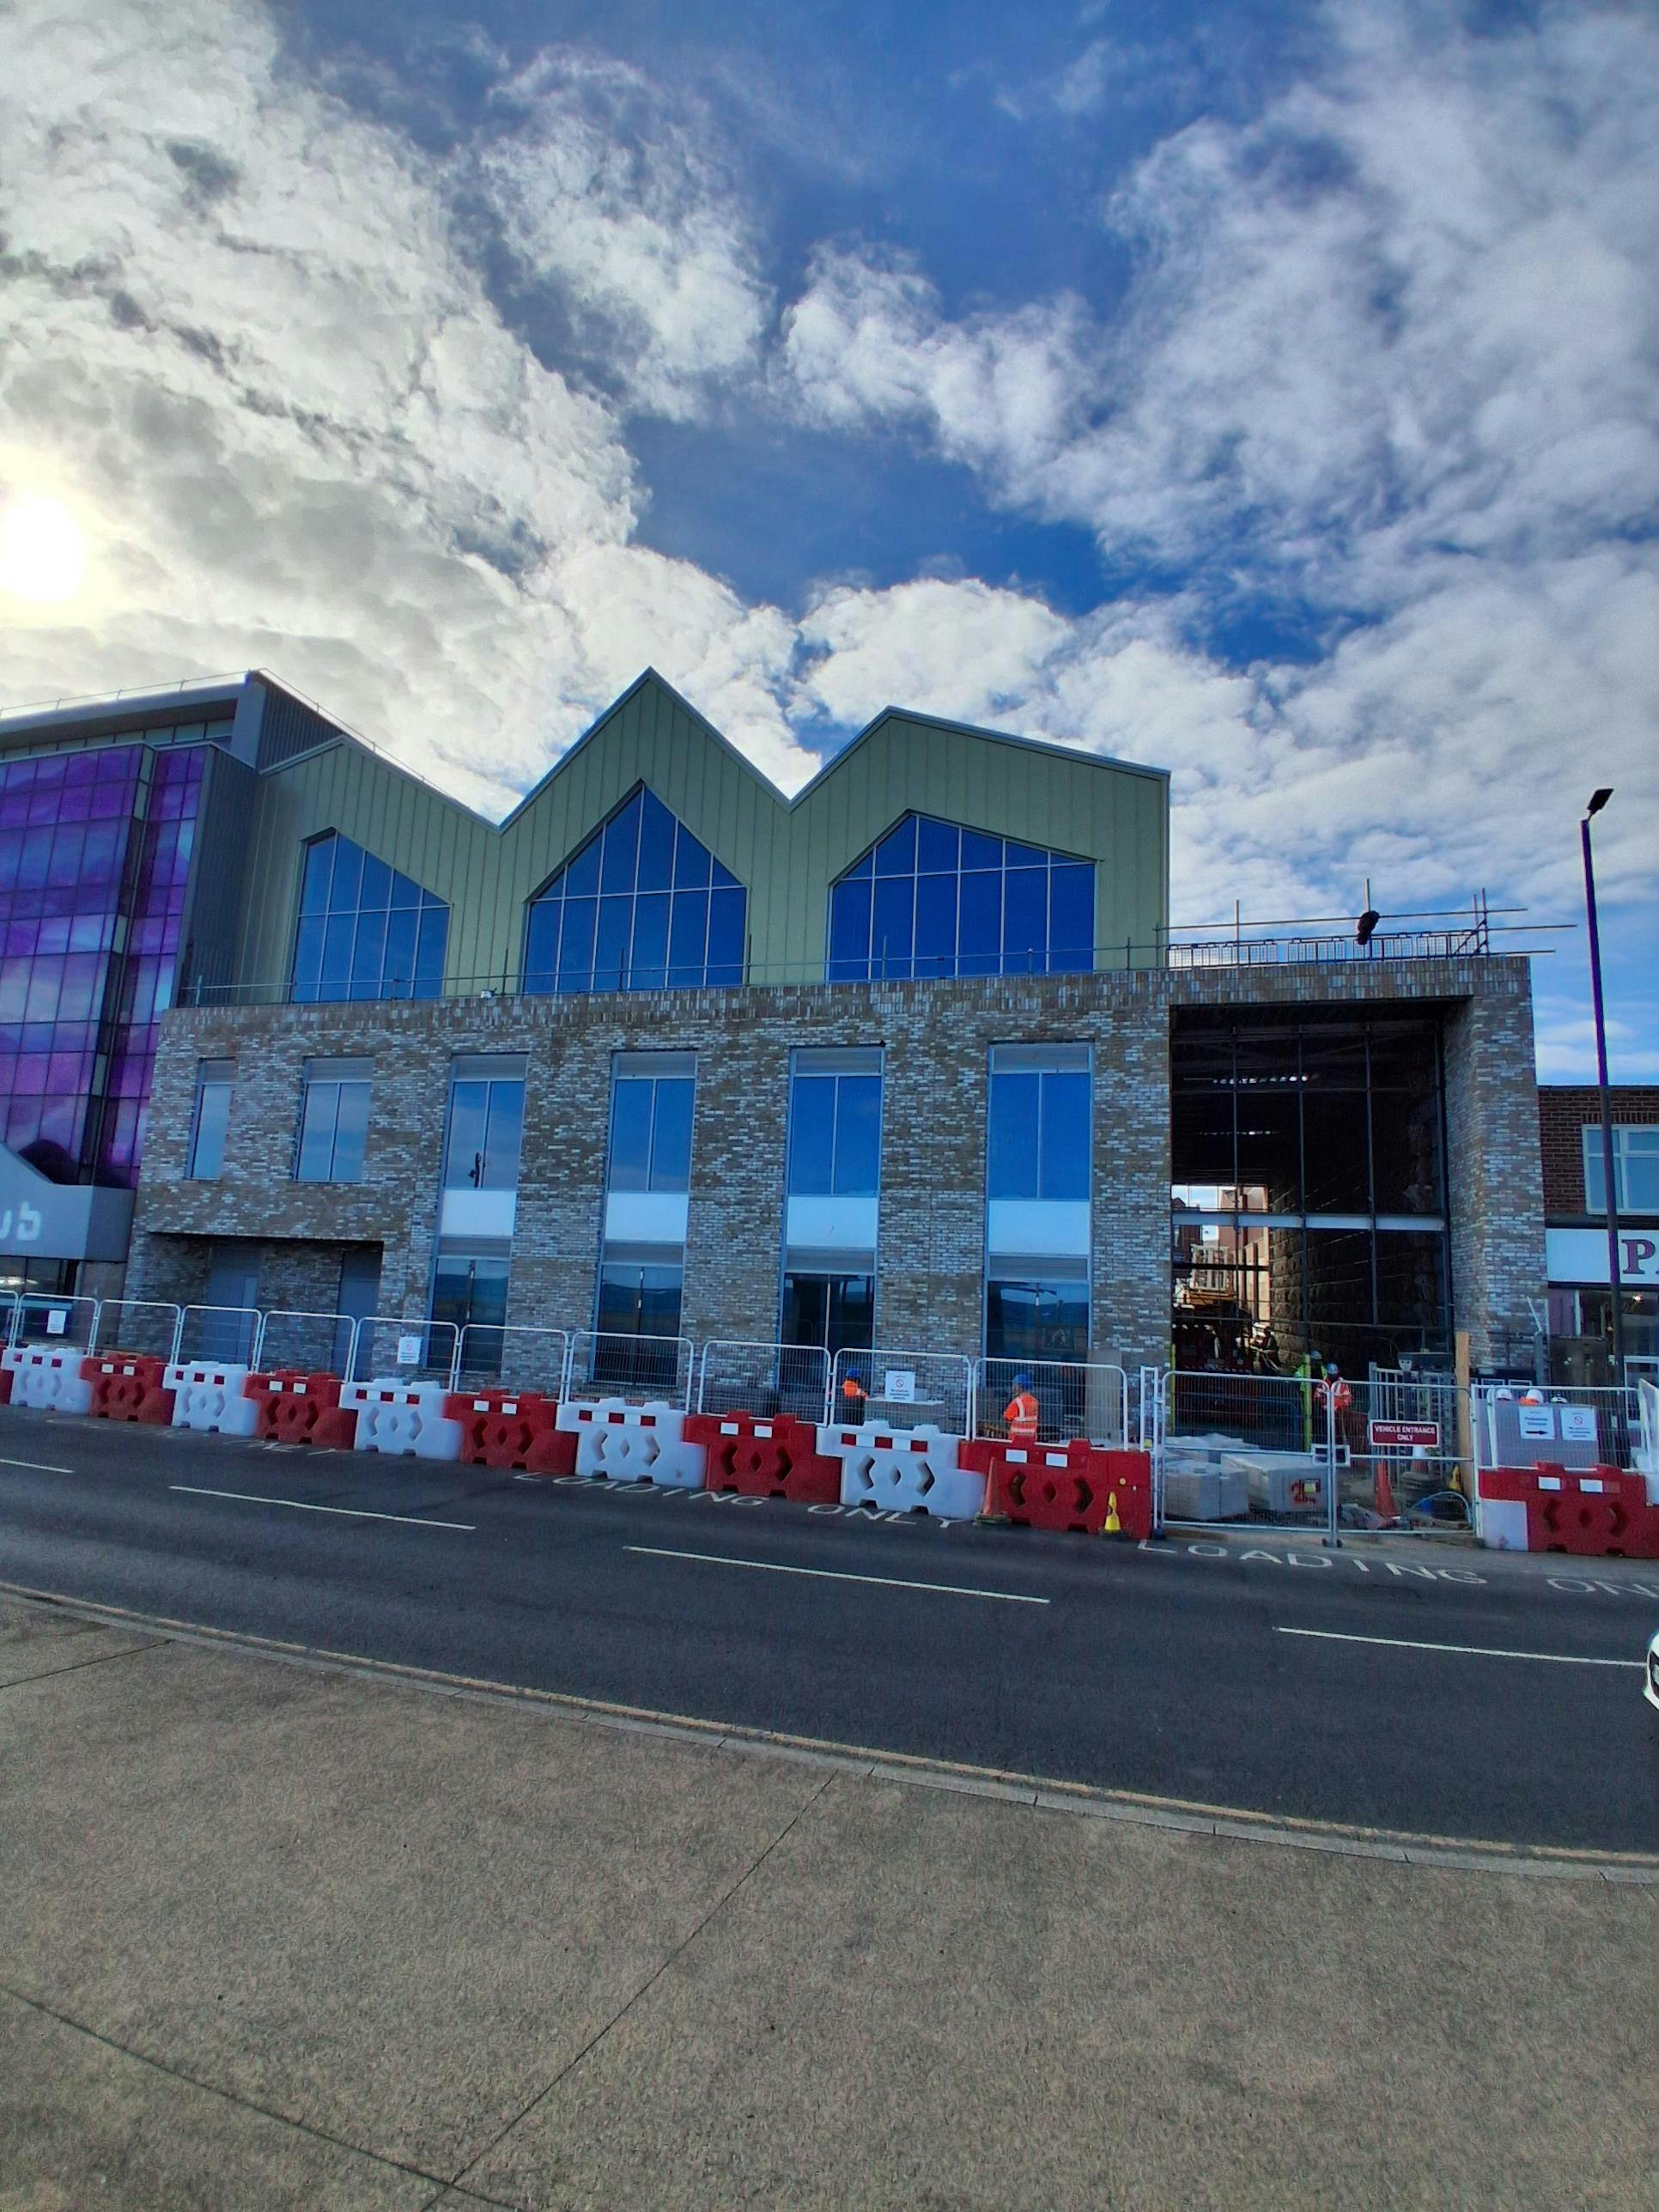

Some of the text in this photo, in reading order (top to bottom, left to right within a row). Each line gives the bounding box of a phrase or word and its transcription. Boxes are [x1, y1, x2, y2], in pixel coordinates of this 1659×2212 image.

[1621, 1238, 1659, 1275] P
[1402, 1426, 1435, 1435] ENTRANCE
[513, 1471, 967, 1528] LOADING ONLY
[1137, 1538, 1488, 1585] LOADING
